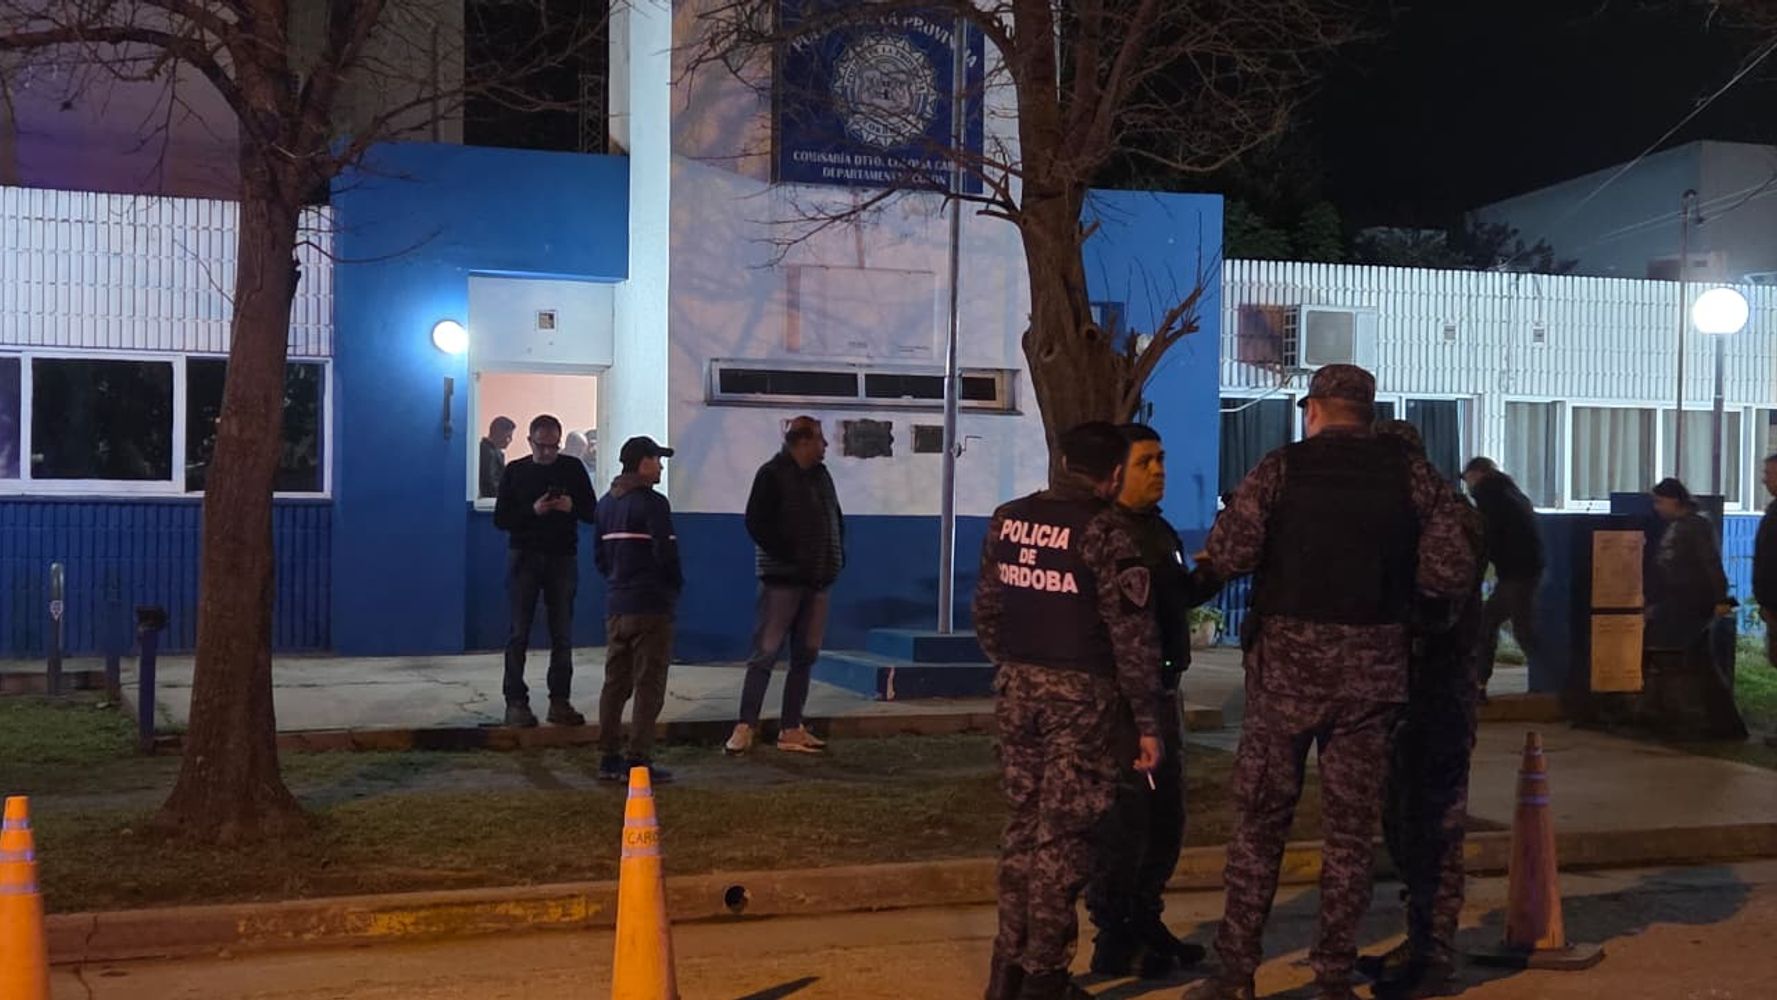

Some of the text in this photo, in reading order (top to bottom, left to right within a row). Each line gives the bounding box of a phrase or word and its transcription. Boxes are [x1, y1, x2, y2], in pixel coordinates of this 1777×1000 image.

[903, 16, 977, 68] PROVIIA
[1000, 519, 1071, 550] POLICIA
[1018, 548, 1037, 566] DE
[998, 563, 1079, 594] ORDOBA
